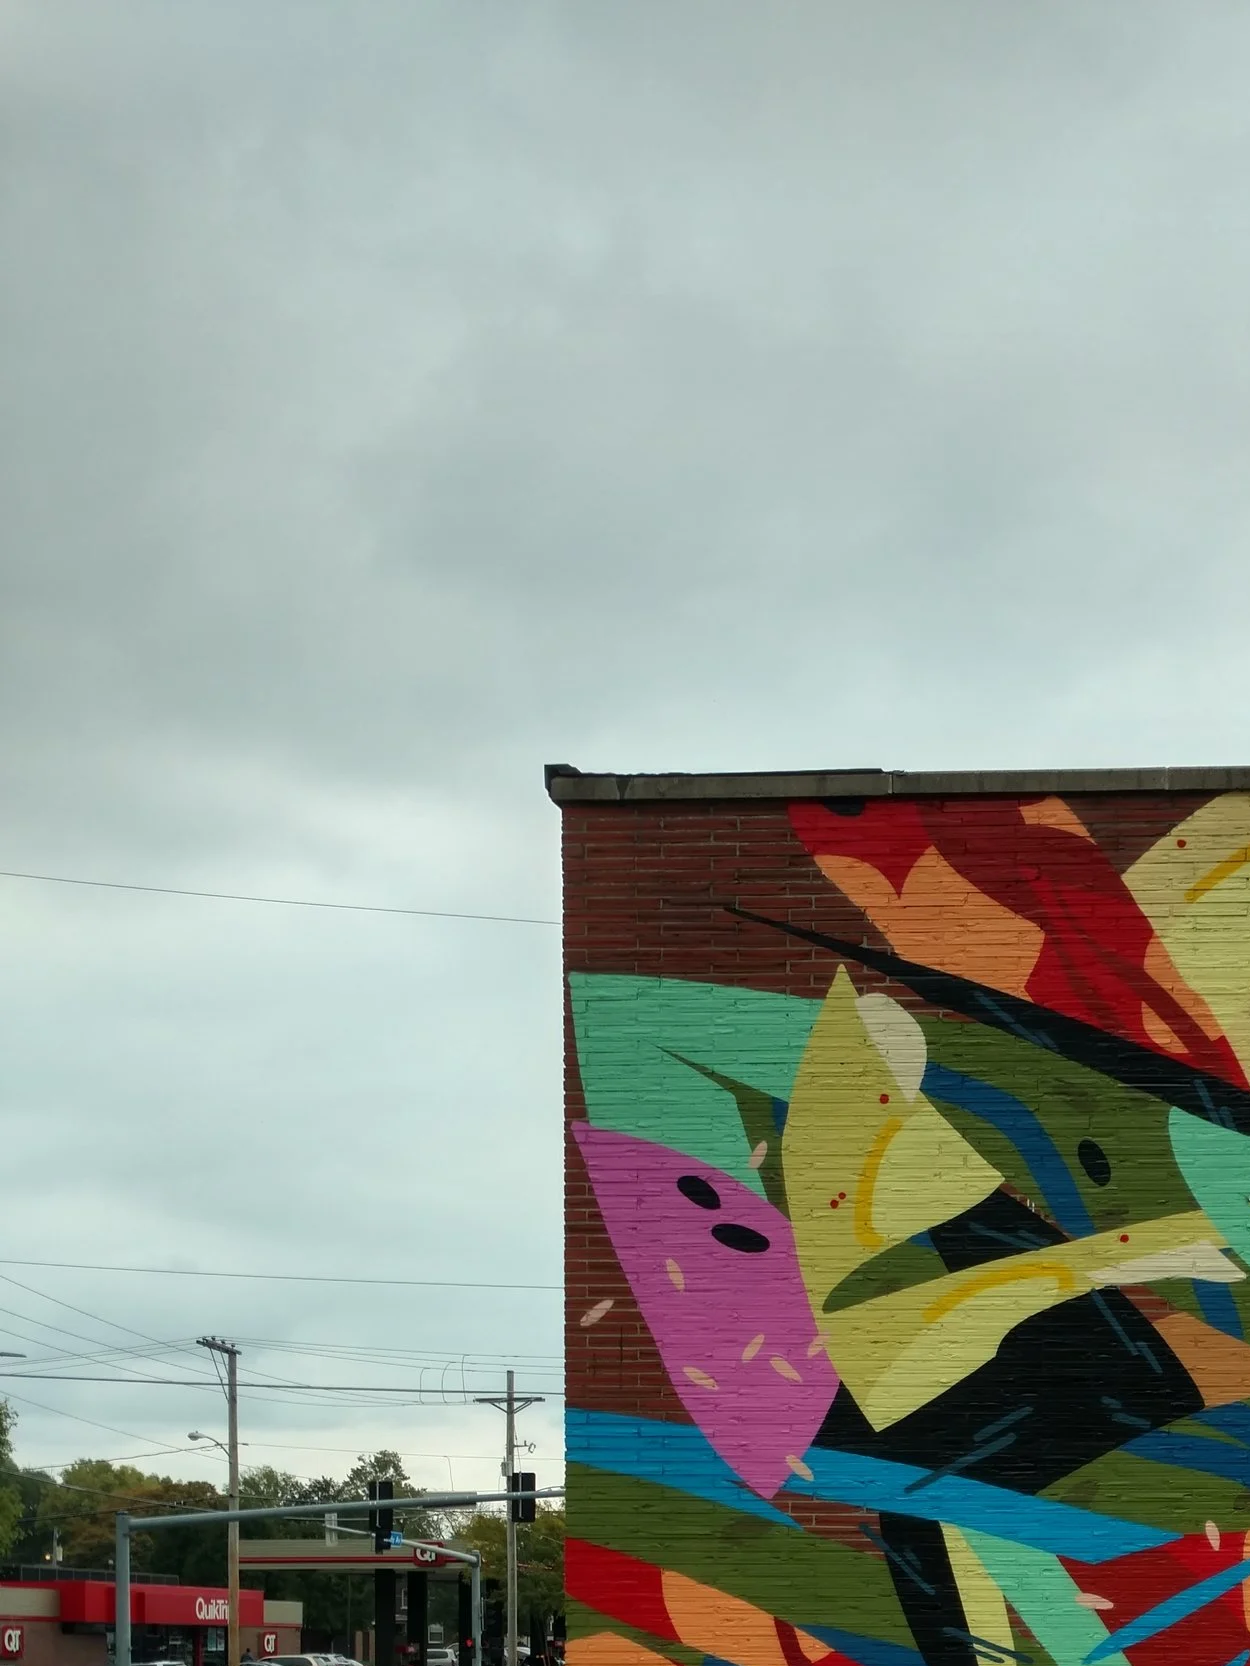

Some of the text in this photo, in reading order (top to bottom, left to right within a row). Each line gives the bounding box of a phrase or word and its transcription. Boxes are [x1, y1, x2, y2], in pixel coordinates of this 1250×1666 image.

[195, 1597, 229, 1624] QuikTri
[4, 1629, 21, 1652] QT
[264, 1633, 276, 1653] QT
